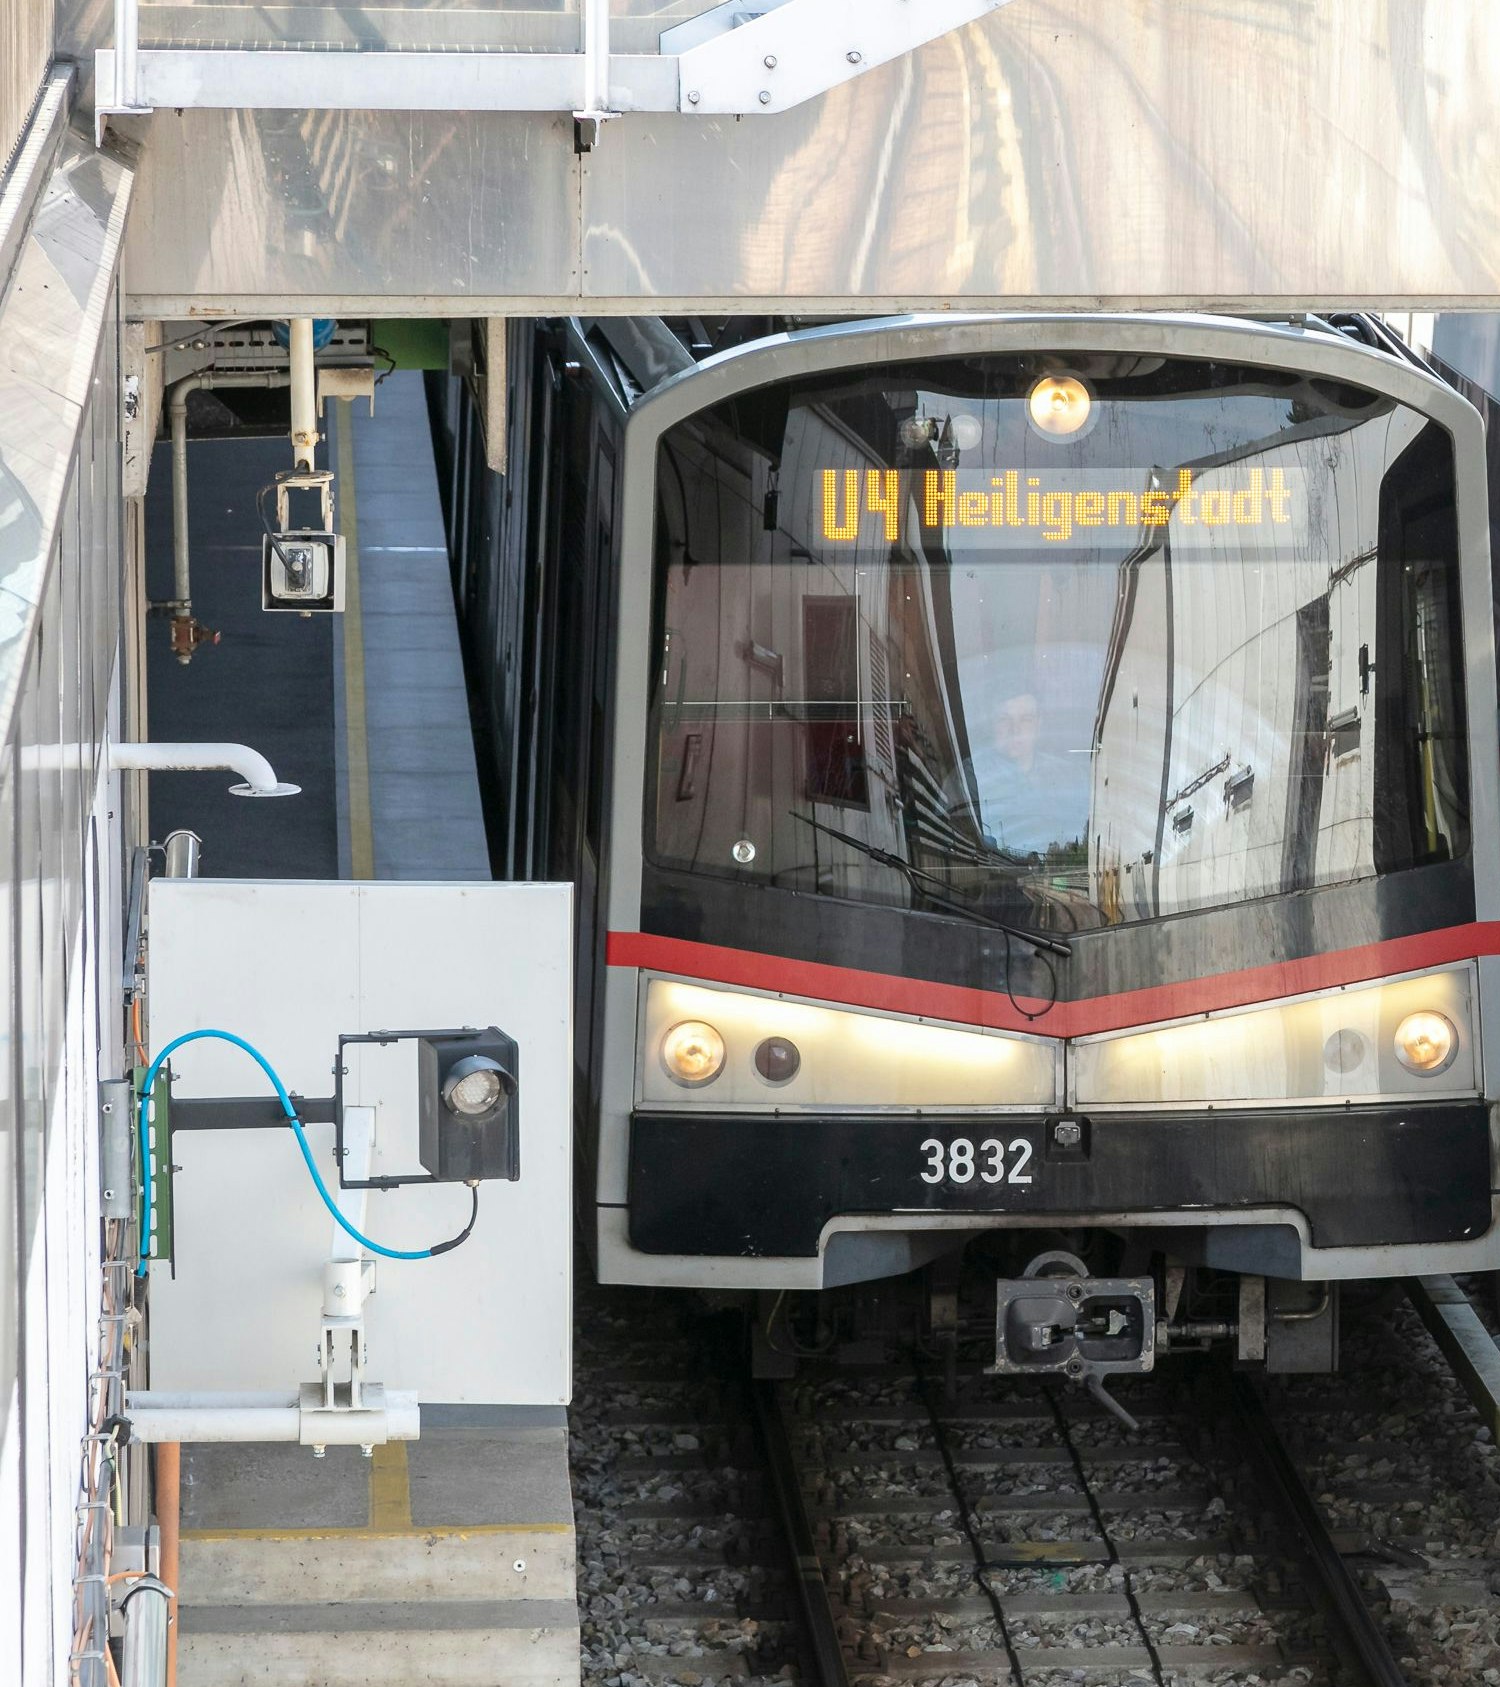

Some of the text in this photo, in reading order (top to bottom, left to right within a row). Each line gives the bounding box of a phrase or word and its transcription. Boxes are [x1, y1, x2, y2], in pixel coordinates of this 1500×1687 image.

[822, 468, 1292, 541] U4 Heiligenstadt
[920, 1138, 1033, 1184] 3832
